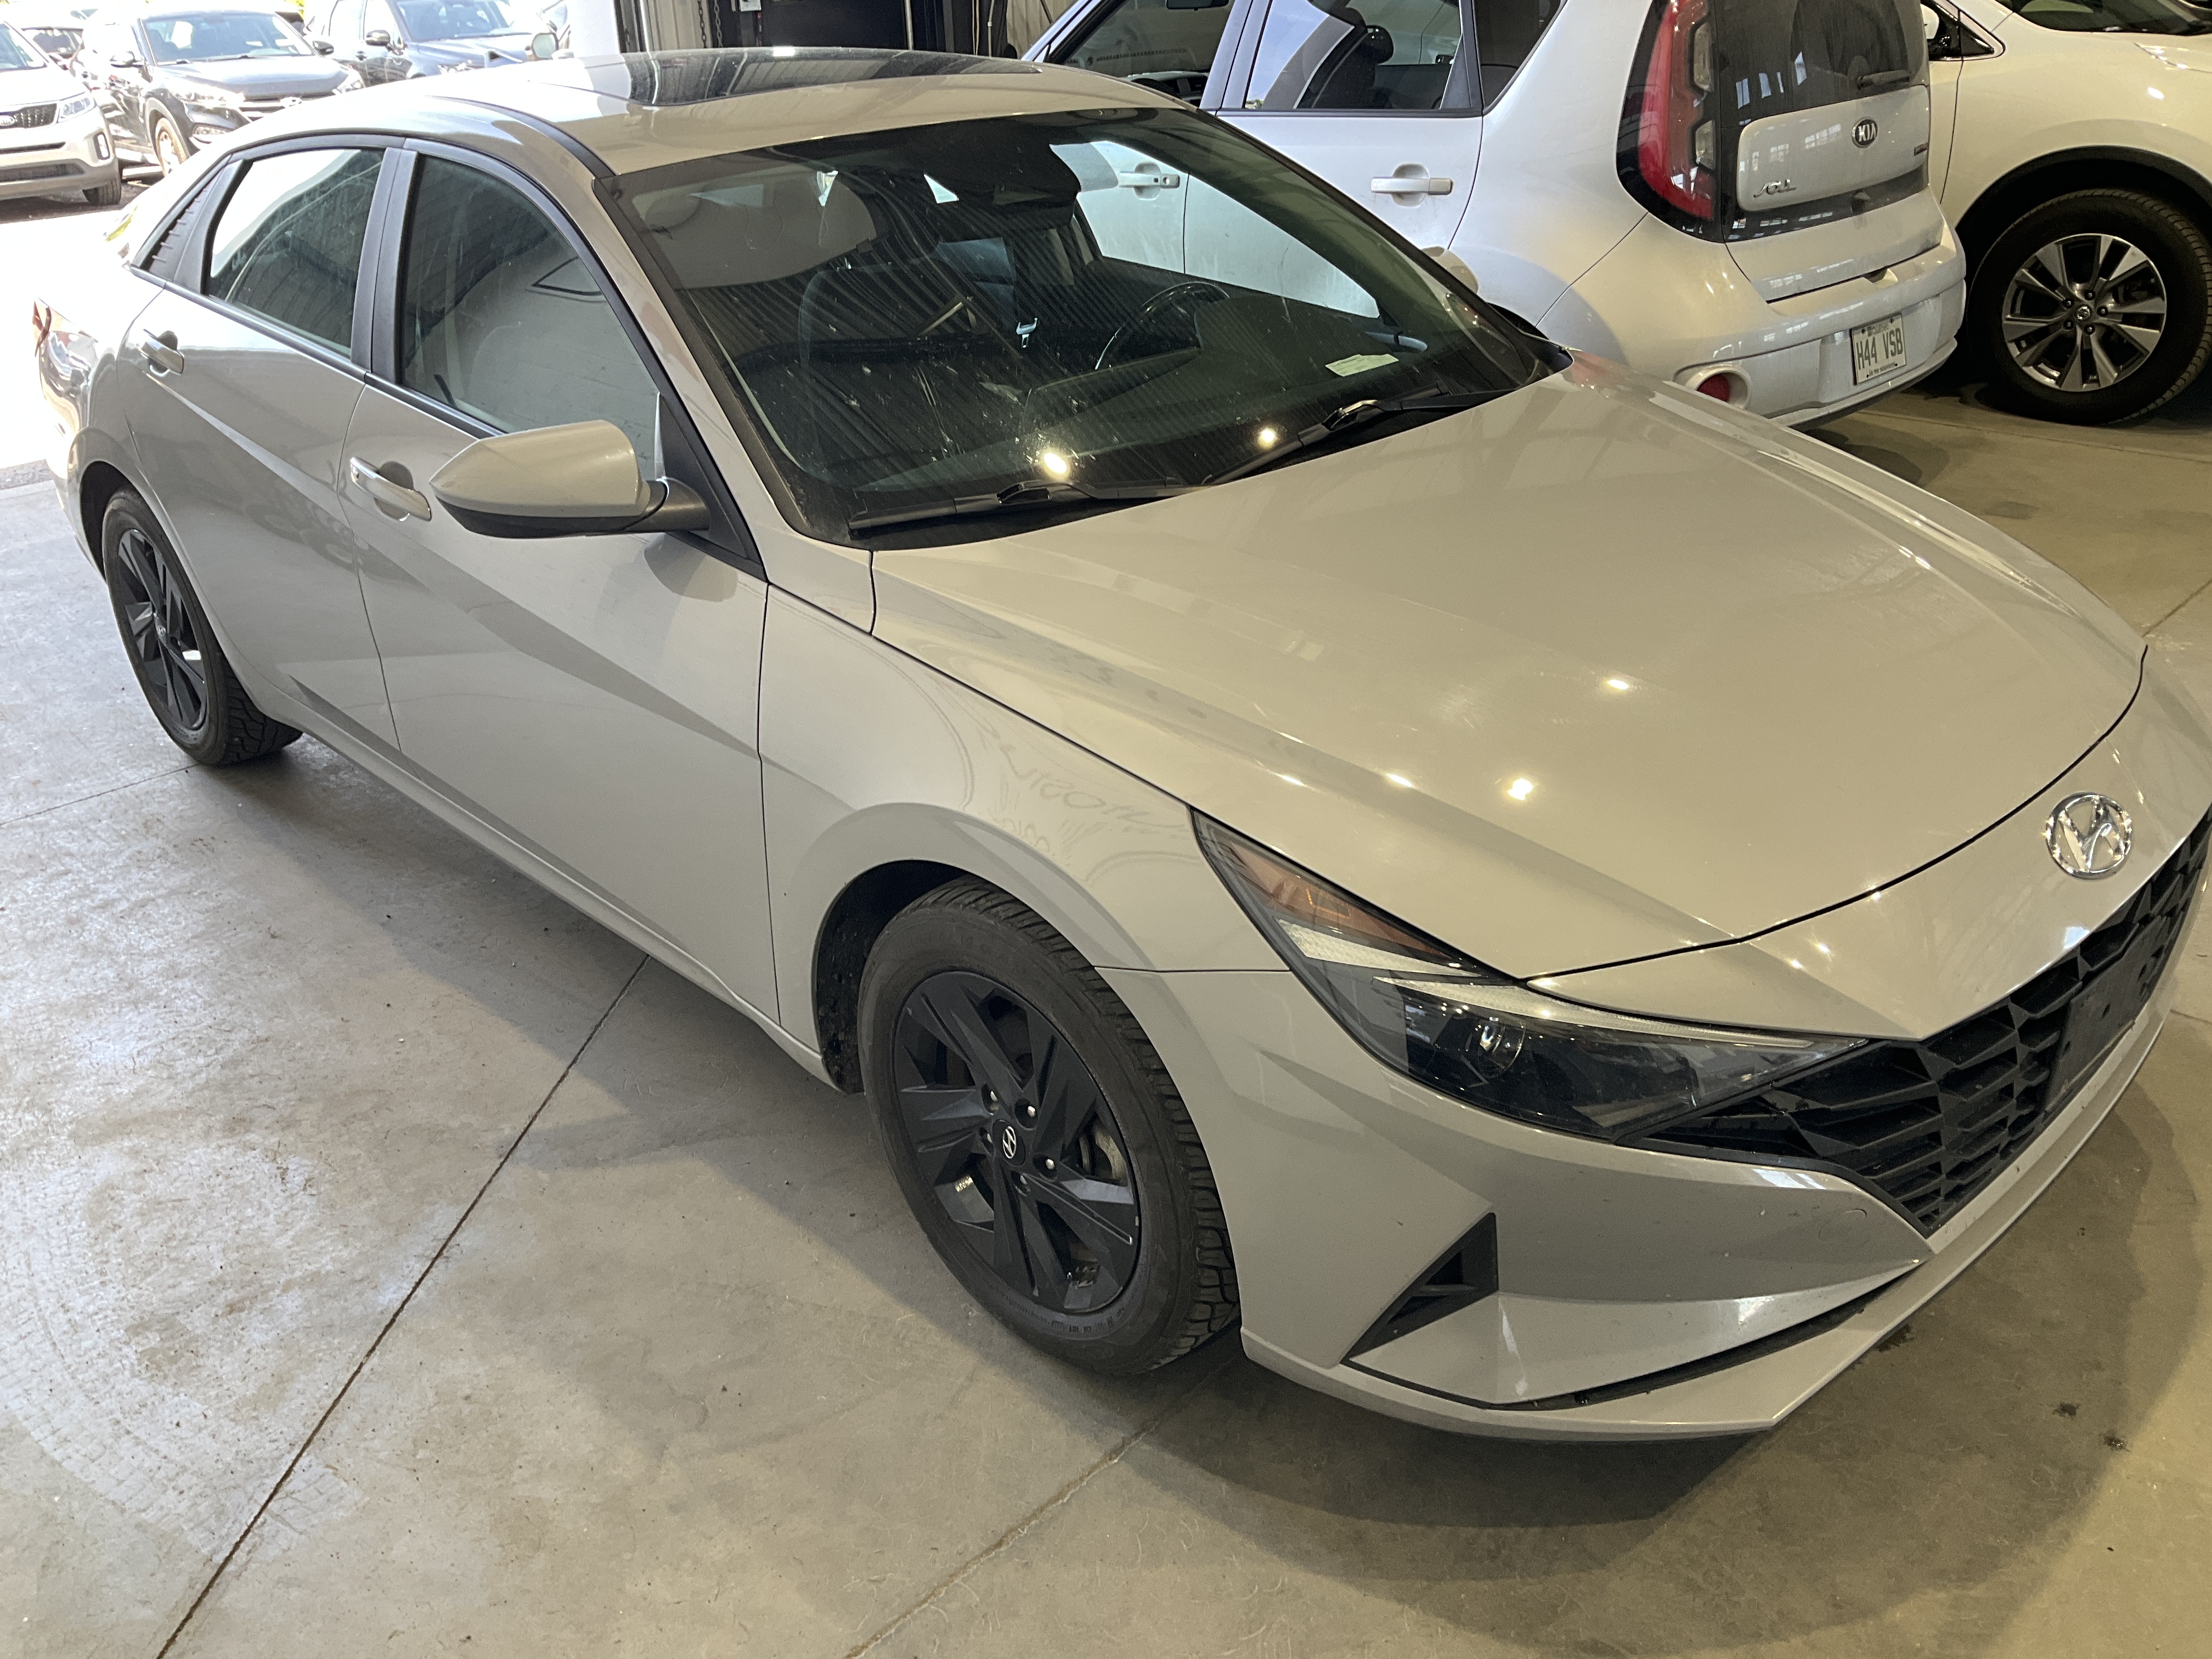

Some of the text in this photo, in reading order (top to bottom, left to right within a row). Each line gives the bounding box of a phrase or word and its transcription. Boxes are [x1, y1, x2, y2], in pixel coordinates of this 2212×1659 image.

[1858, 123, 1876, 142] KIA
[1857, 336, 1877, 370] H44
[1882, 328, 1903, 359] VSB
